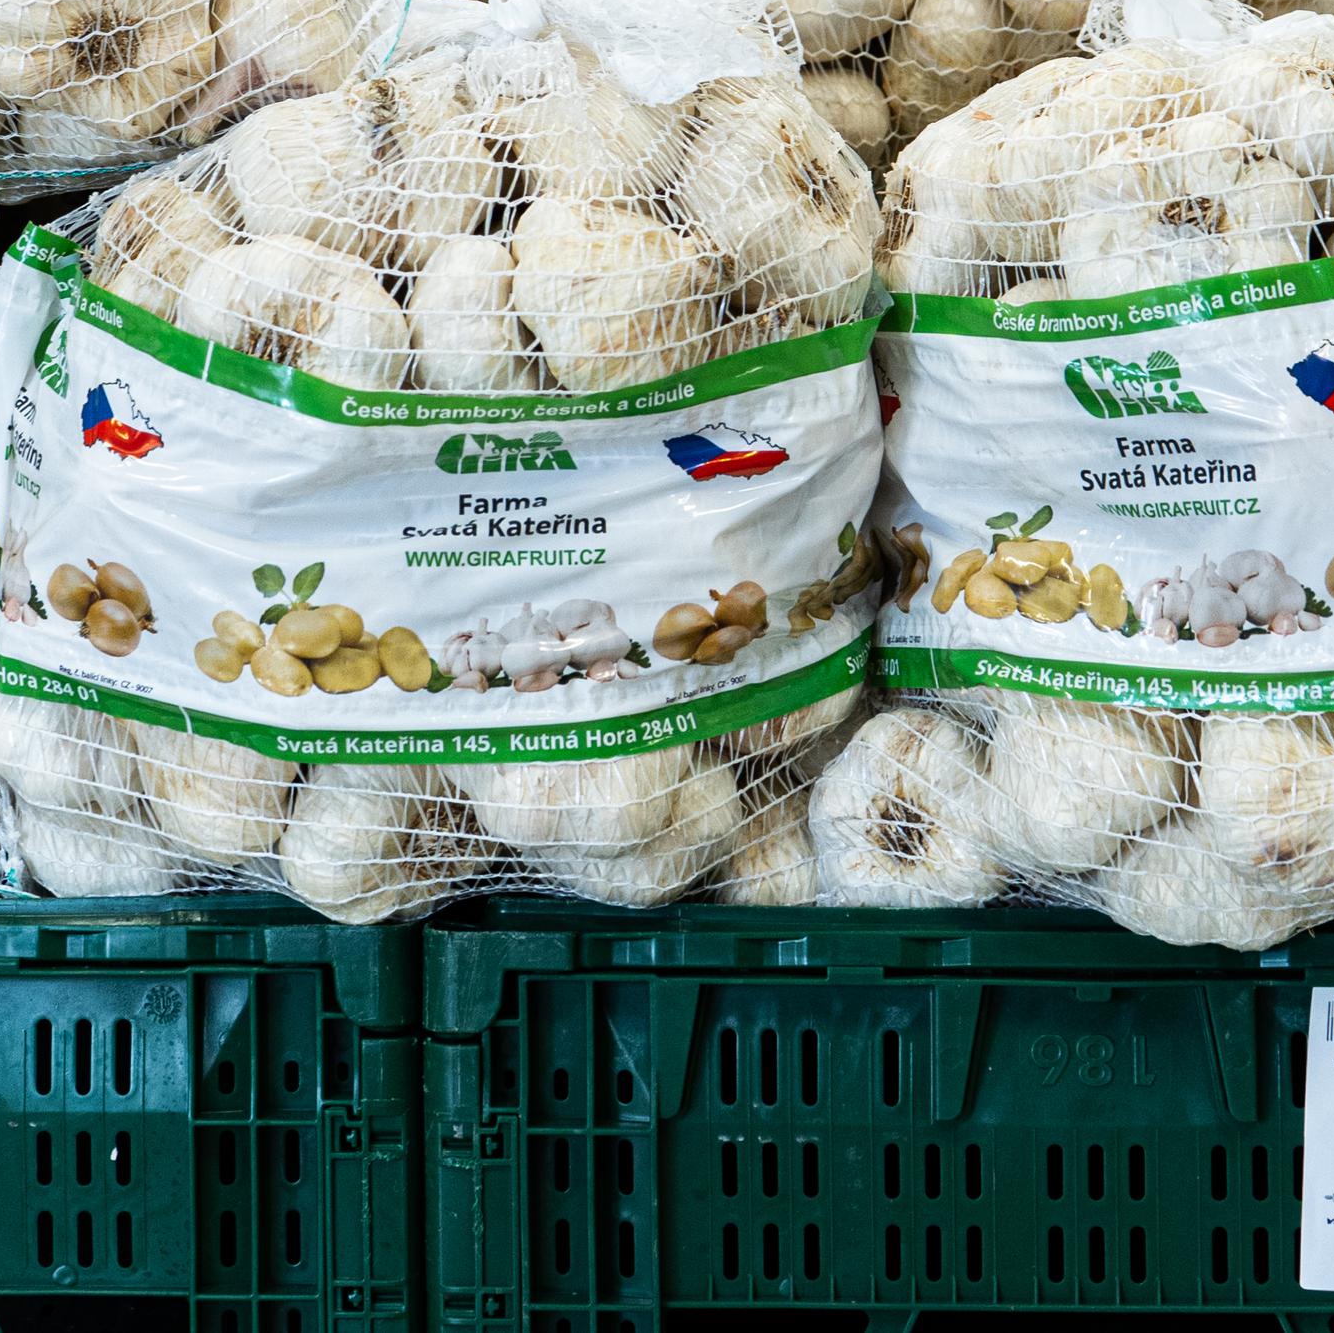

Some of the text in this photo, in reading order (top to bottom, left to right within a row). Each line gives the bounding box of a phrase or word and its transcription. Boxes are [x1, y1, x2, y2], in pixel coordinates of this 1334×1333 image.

[88, 298, 124, 329] cibule
[992, 280, 1297, 333] České brambory, česnek a cibule
[341, 383, 695, 420] České brambory, česnek a cibule
[1115, 436, 1196, 458] Farma
[1080, 459, 1257, 491] Svatá Kateřina
[458, 494, 548, 516] Farma
[1098, 498, 1261, 519] WWW.GIRAFRUIT.CZ
[402, 513, 607, 539] Svatá Kateřina
[405, 549, 607, 567] WWW.GIRAFRUIT.CZ
[43, 677, 75, 698] 284
[77, 685, 99, 703] 01
[974, 660, 1033, 683] Svatá
[1038, 667, 1129, 693] Kateřina
[1136, 676, 1178, 698] 145,
[1191, 679, 1259, 700] Kutná
[1267, 680, 1322, 700] Hora
[277, 712, 697, 755] Svatá Kateřina 145, Kutná Hora 284 01
